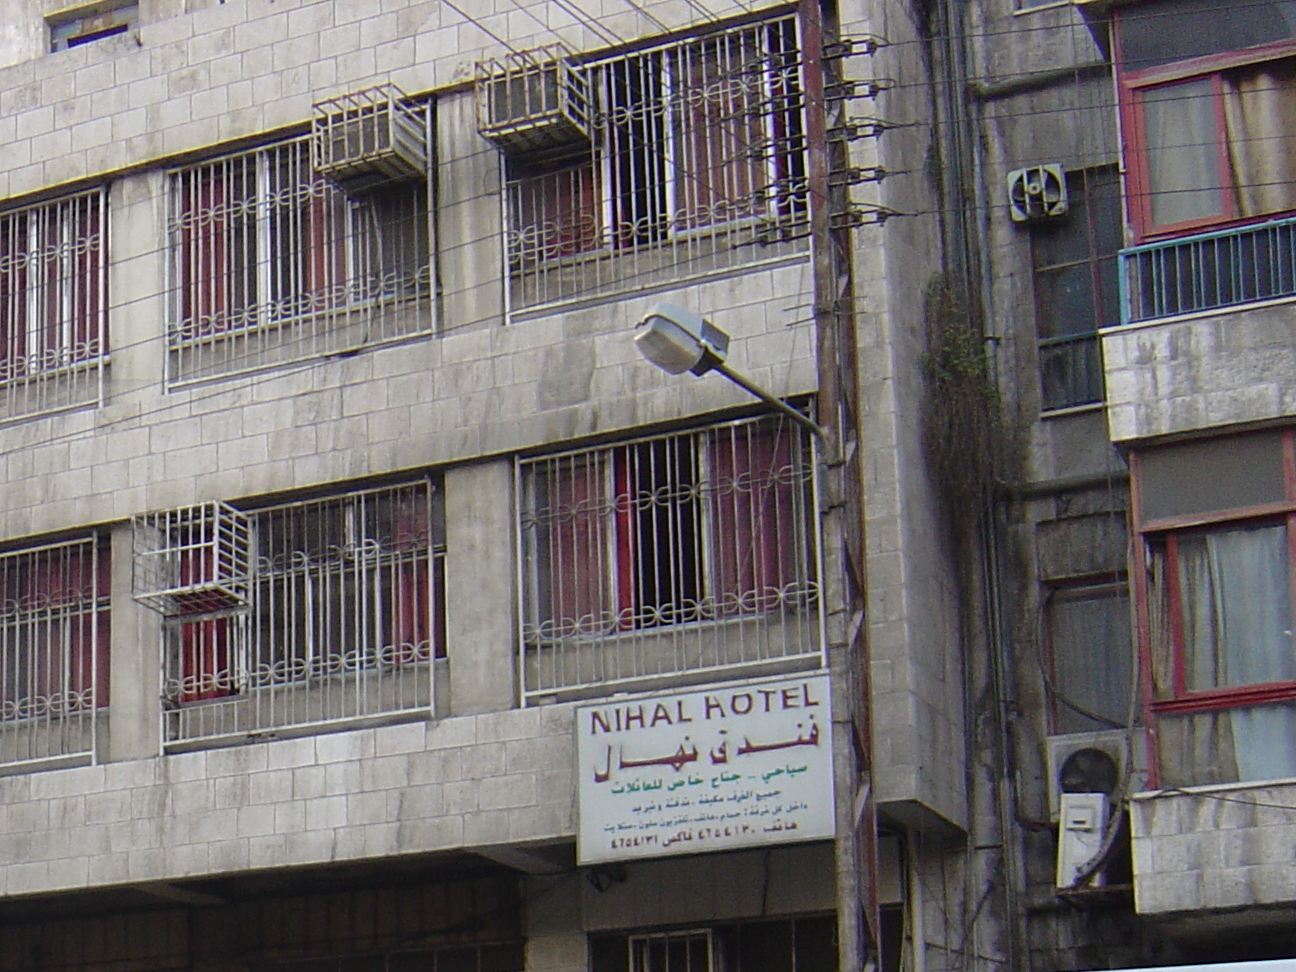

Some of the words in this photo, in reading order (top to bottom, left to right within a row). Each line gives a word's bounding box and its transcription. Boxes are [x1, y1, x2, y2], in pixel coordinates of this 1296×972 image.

[591, 700, 692, 735] NIHAL
[704, 683, 820, 720] HOTEL
[709, 714, 820, 765] فندق
[594, 736, 698, 784] نهال
[711, 772, 742, 789] جناح
[761, 764, 808, 784] سياحي
[611, 778, 663, 795] للعائلات
[667, 774, 704, 792] خاص
[698, 794, 724, 806] مكيفة
[727, 790, 753, 803] الغرف
[755, 789, 782, 802] جميع
[763, 818, 798, 833] هاتف
[662, 829, 693, 848] فاكس
